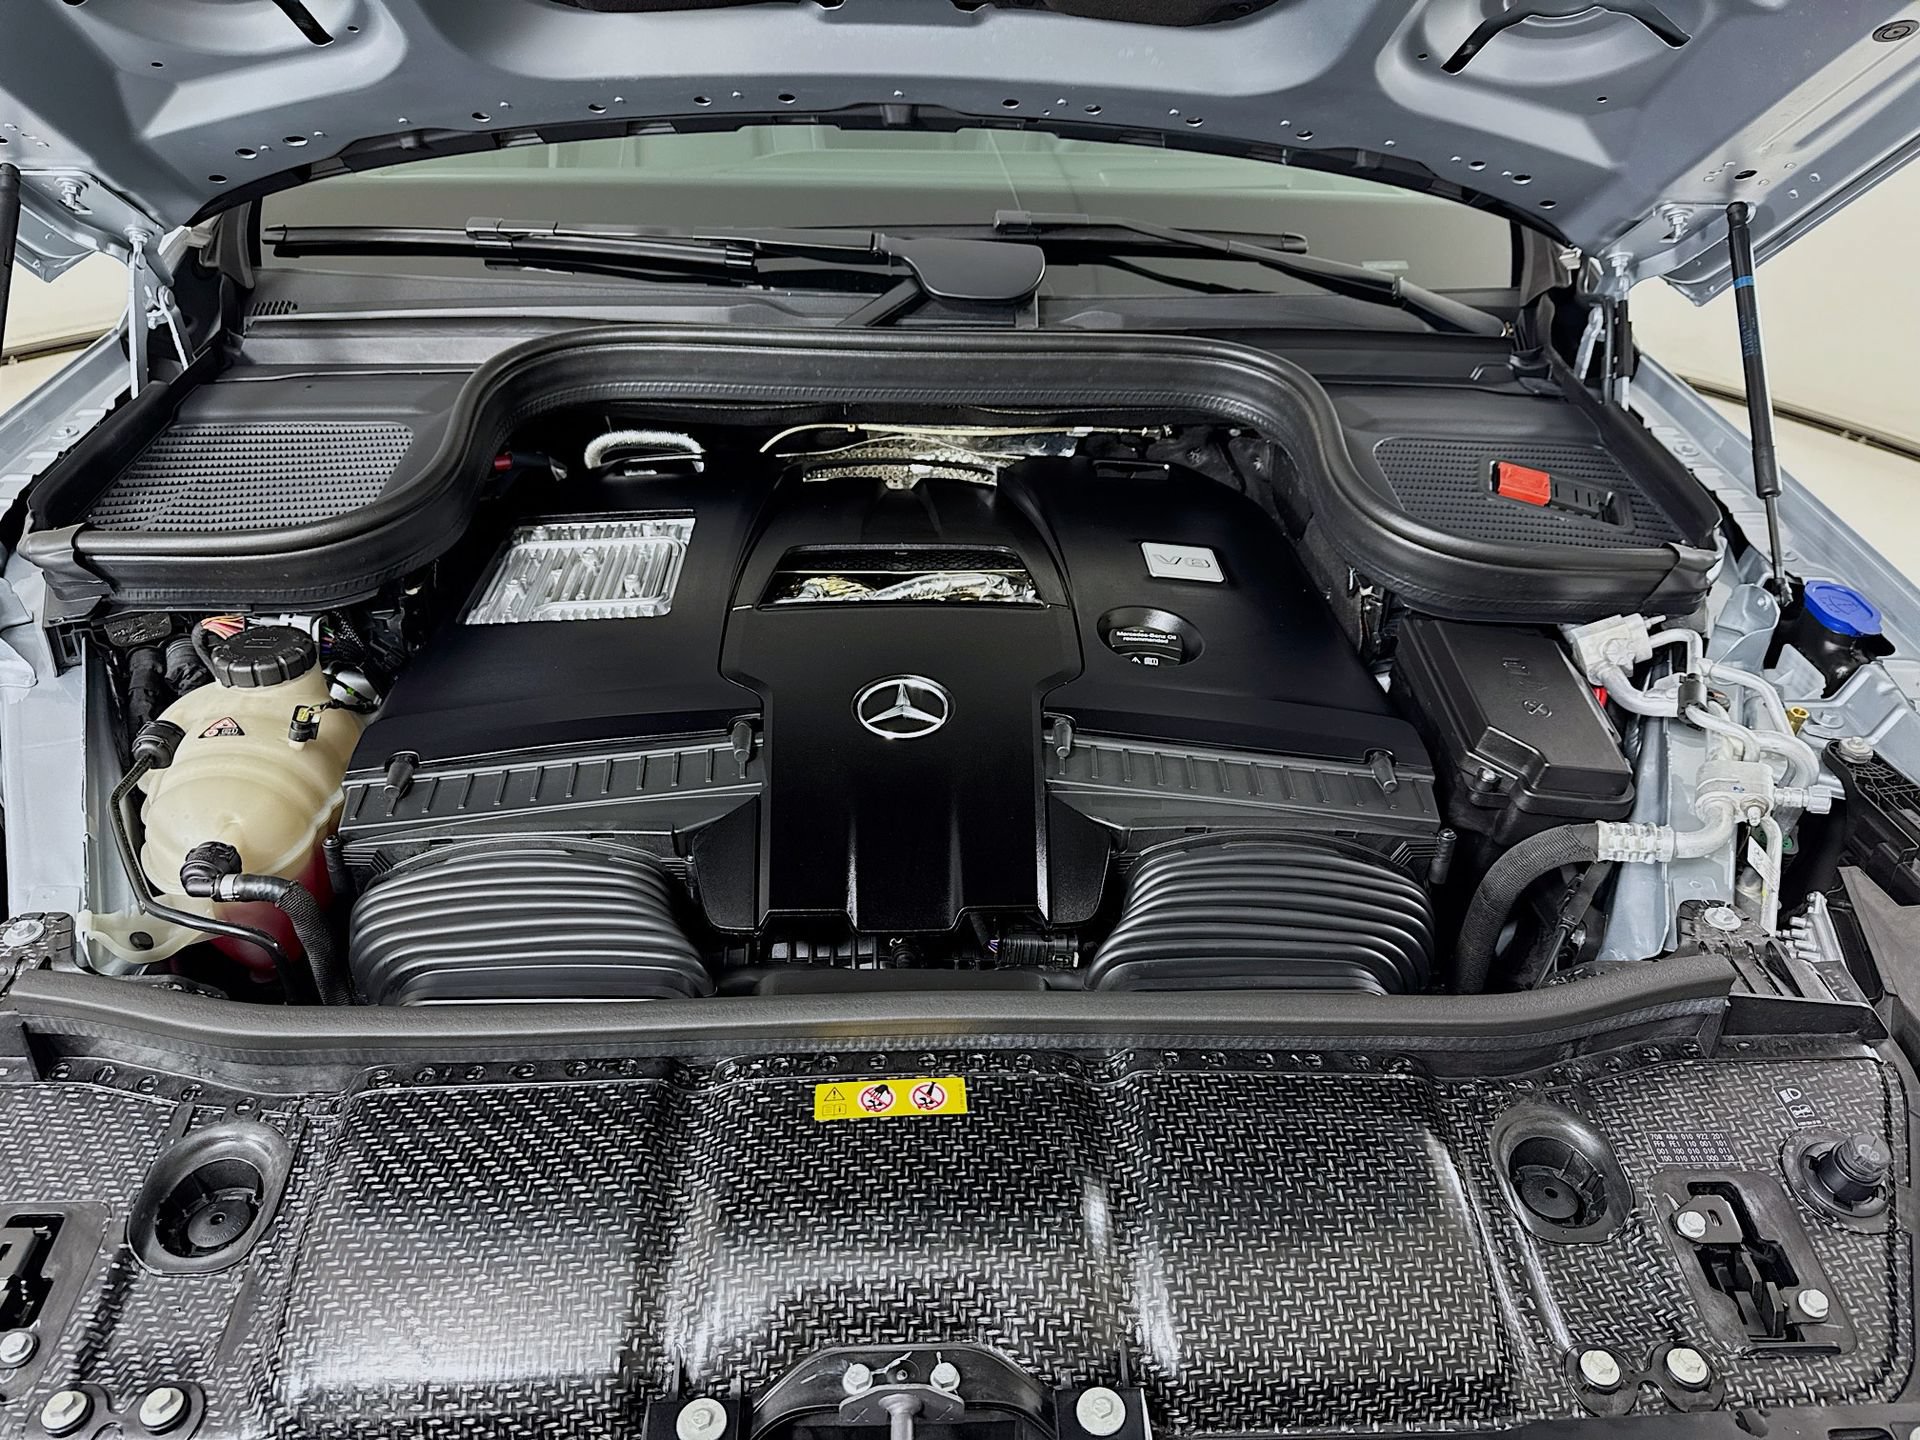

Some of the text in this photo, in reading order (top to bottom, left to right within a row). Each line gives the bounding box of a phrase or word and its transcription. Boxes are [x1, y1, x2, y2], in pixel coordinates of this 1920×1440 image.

[1116, 631, 1166, 639] Mercedes-Benz
[1122, 636, 1169, 644] recommended
[1656, 1147, 1731, 1155] 001 100 010 010 011
